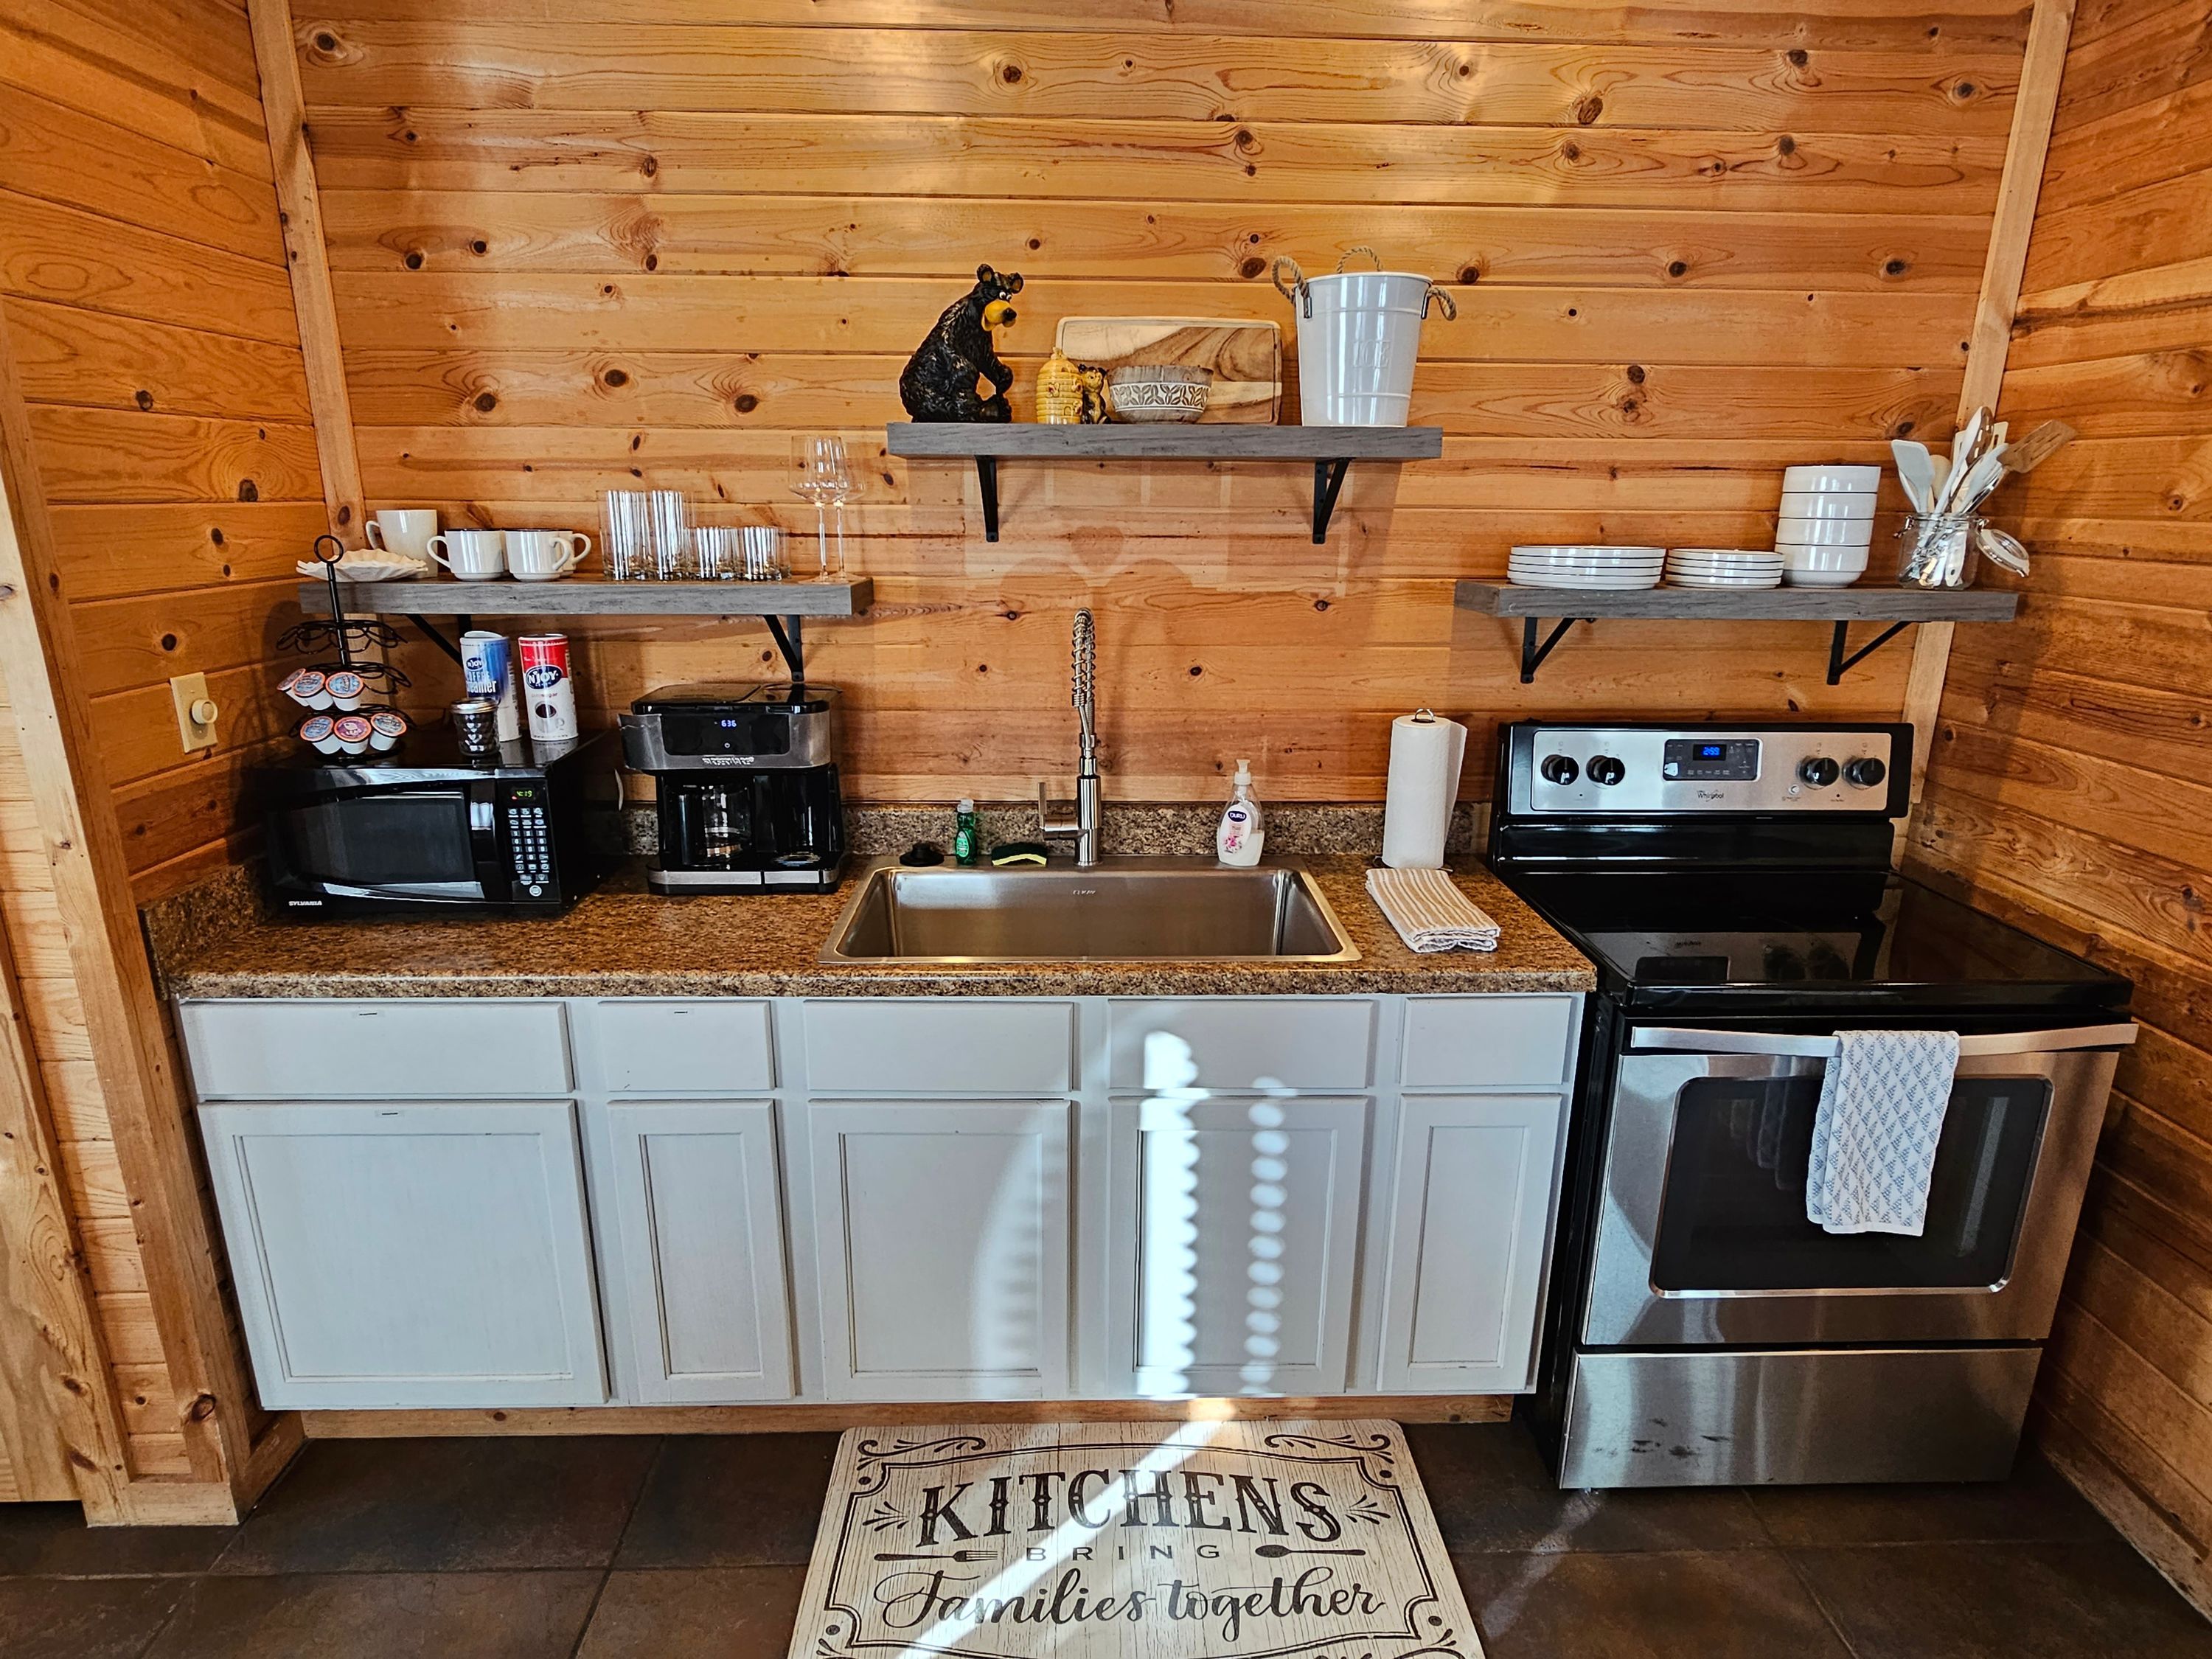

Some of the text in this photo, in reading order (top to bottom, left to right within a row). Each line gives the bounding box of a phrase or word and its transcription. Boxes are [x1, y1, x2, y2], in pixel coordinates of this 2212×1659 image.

[1353, 339, 1391, 368] ICE
[1697, 790, 1724, 801] Whirlpool
[915, 1468, 1342, 1548] KITCHENS
[1026, 1544, 1220, 1562] BRING
[873, 1566, 1386, 1642] Families together
